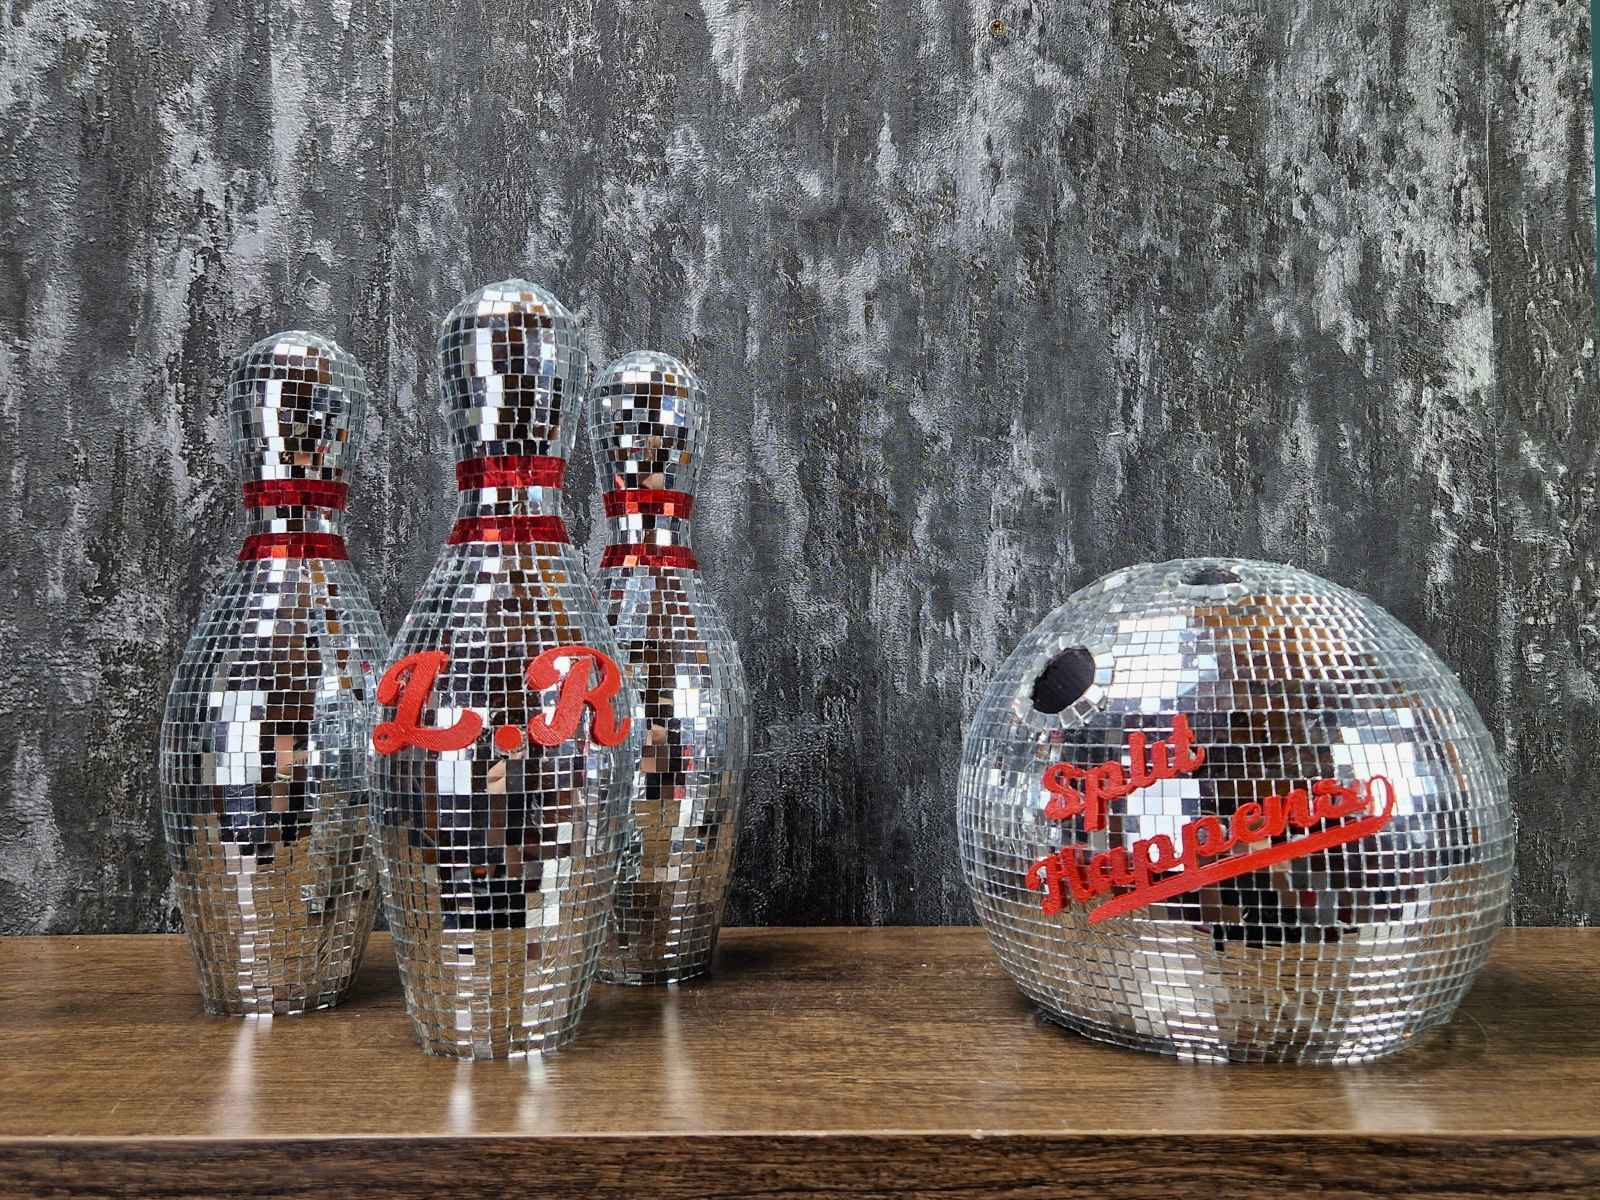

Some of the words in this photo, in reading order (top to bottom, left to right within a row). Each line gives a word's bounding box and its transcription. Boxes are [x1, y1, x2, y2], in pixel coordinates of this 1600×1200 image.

[373, 645, 631, 756] L.R
[1043, 713, 1206, 832] Split
[1025, 775, 1394, 924] Happens
